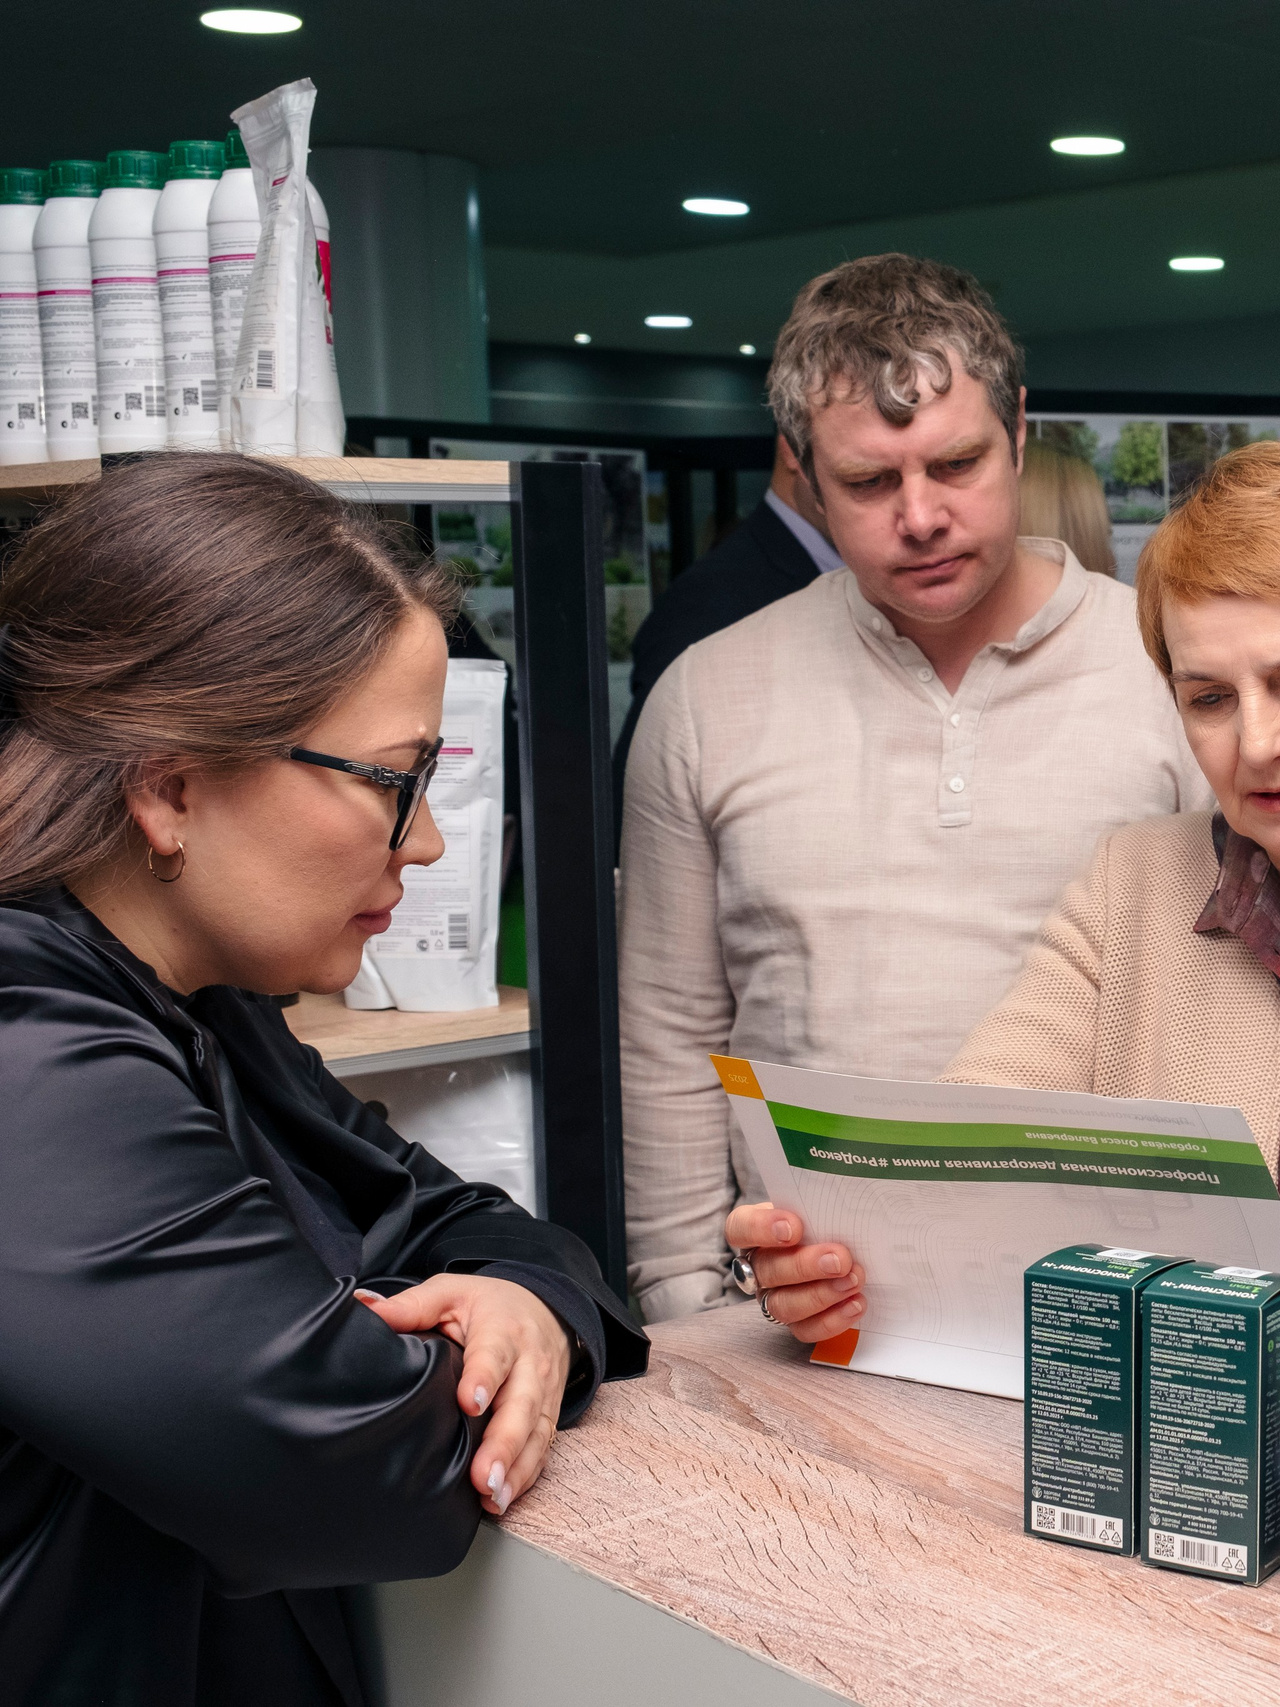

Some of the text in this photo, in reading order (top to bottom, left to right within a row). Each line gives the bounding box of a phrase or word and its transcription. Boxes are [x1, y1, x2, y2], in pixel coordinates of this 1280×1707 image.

[727, 1072, 750, 1084] 2025
[1025, 1130, 1207, 1154] Горбачёва Олеся Валерьевна
[809, 1145, 1221, 1185] Профессиональная декоративная линия #ProДекор
